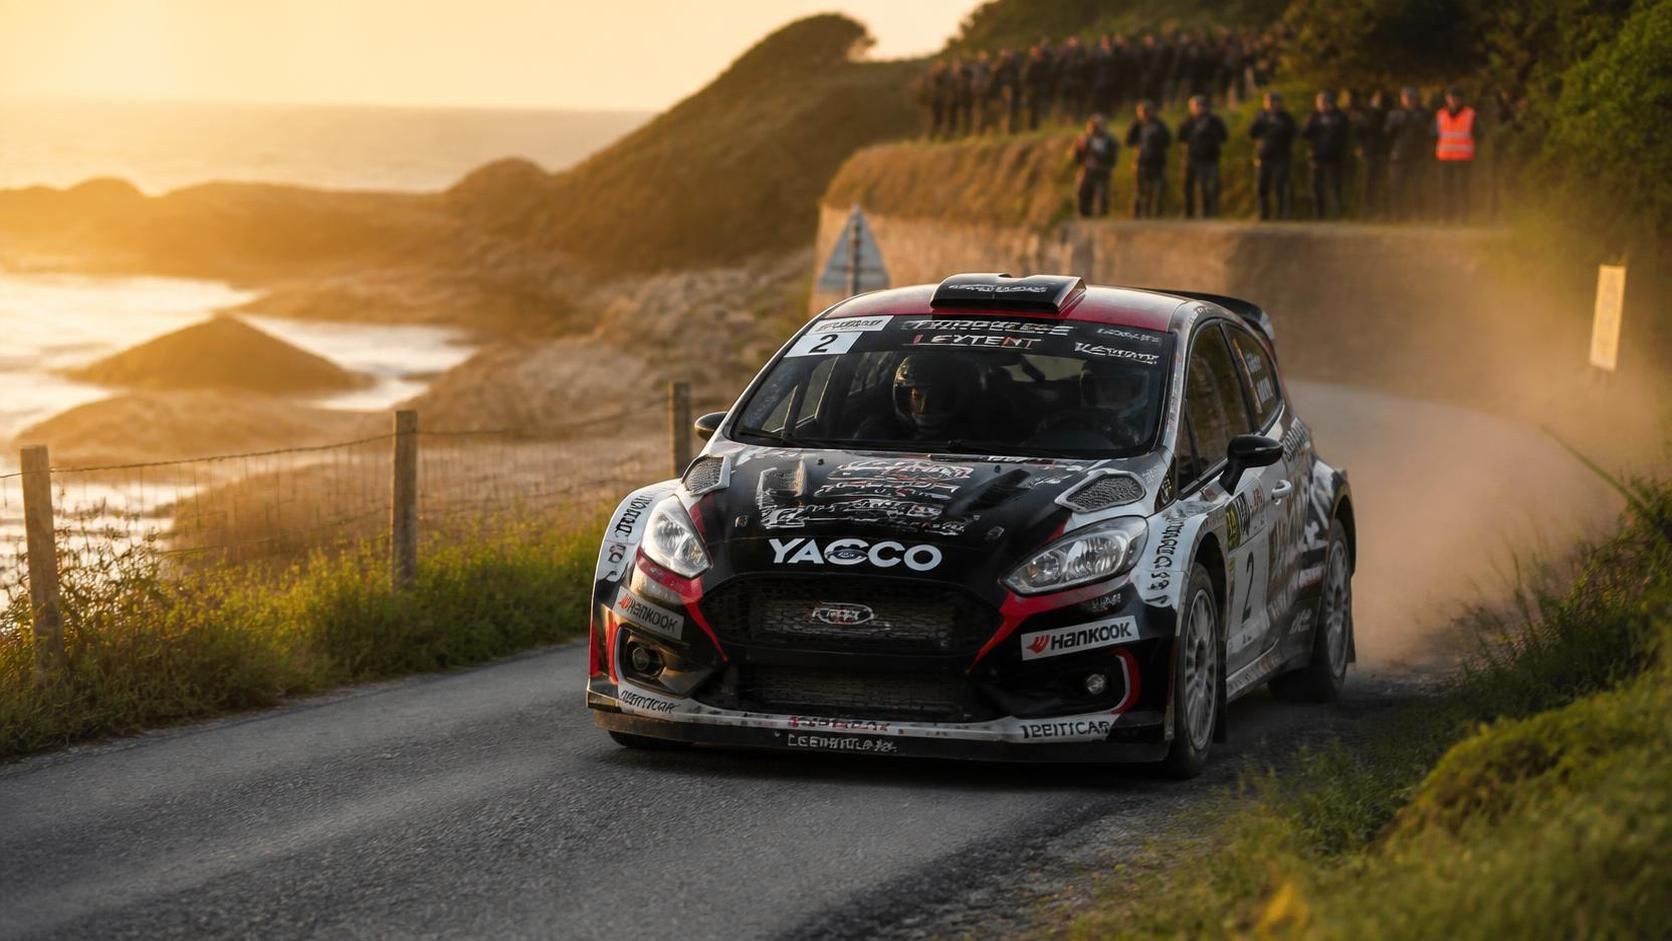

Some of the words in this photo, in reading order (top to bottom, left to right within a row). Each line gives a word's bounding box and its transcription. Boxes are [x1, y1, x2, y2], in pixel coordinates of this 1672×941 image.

[809, 334, 838, 353] 2
[768, 537, 943, 571] YACCO
[1242, 551, 1254, 624] 2
